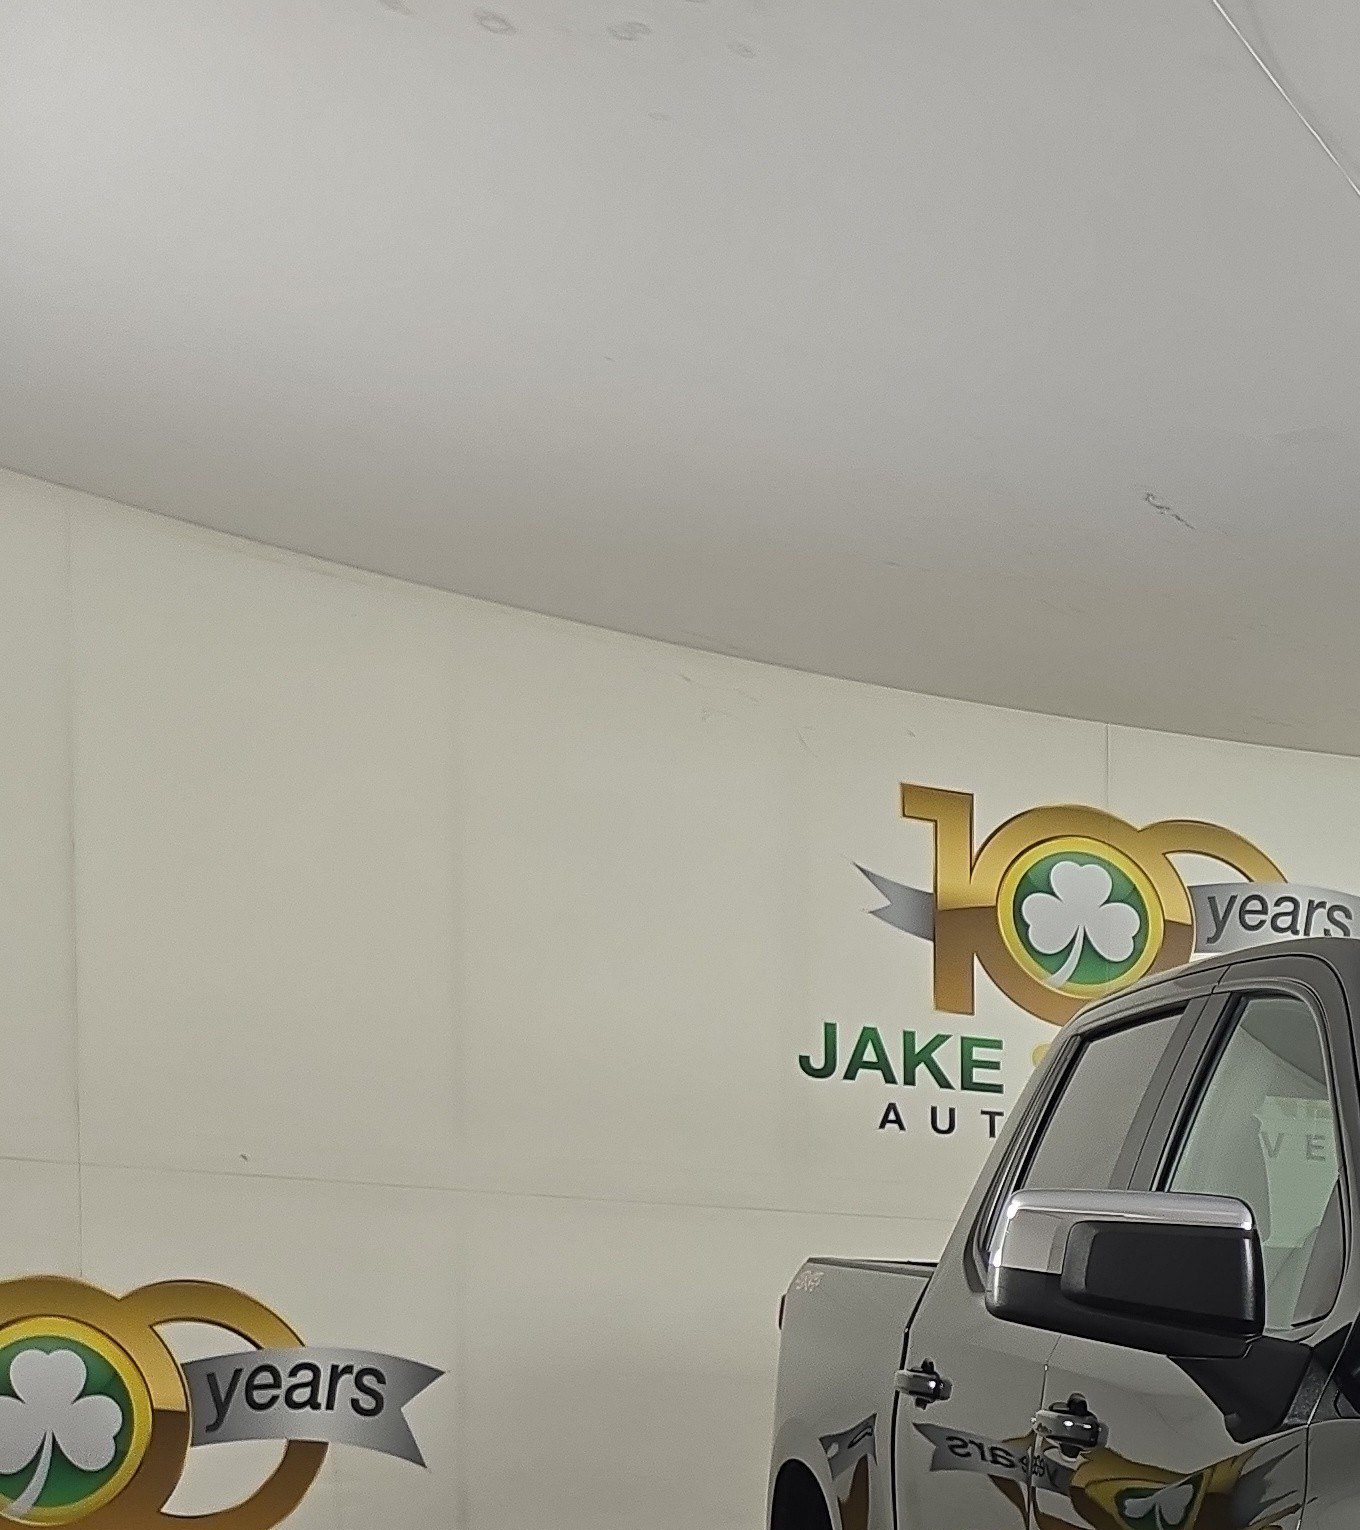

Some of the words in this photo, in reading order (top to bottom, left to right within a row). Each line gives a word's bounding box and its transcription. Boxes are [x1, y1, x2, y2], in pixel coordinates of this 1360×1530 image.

[1206, 886, 1353, 944] years
[799, 1022, 1004, 1094] JAKE
[205, 1361, 387, 1432] years
